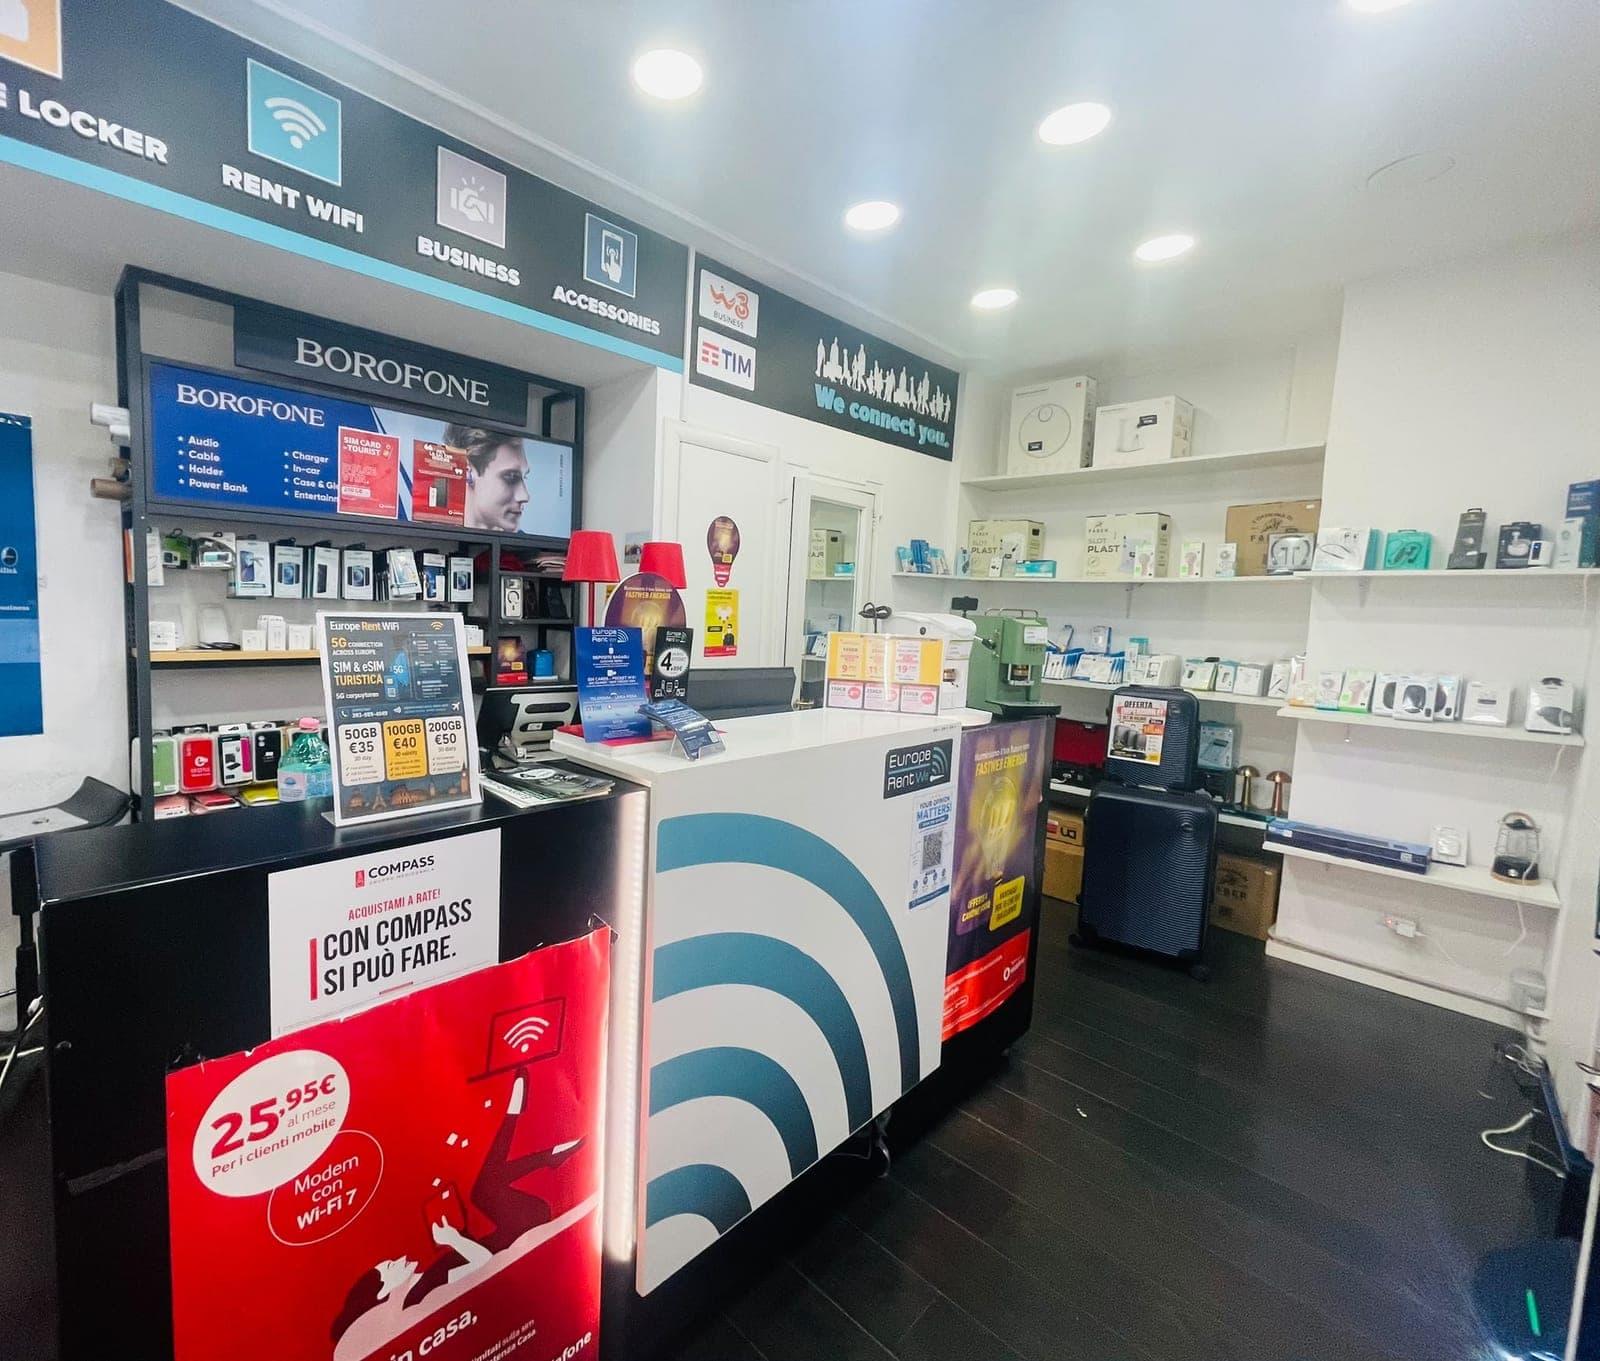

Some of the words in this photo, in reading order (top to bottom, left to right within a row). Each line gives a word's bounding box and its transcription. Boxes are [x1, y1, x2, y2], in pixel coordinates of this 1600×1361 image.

[19, 89, 168, 164] LOCKER
[222, 163, 300, 209] RENT
[305, 195, 364, 233] WIFI
[417, 235, 521, 286] BUSINESS
[552, 285, 661, 335] ACCESSORIES
[713, 311, 744, 329] BUSINESS
[294, 337, 490, 406] BOROFONE
[721, 348, 751, 378] TIM
[176, 383, 325, 427] BOROFONE
[814, 383, 845, 414] We
[850, 402, 915, 436] connect
[919, 424, 950, 448] you.
[188, 435, 219, 448] Audio
[344, 436, 359, 445] SIM
[360, 439, 381, 449] CARD
[188, 450, 220, 462] Cable
[292, 451, 328, 464] Charger
[189, 464, 224, 477] Holder
[292, 464, 320, 476] In-car
[189, 478, 220, 491] Power
[223, 482, 248, 493] Bank
[293, 477, 316, 488] Case
[318, 479, 325, 488] &
[1087, 544, 1120, 553] PLAST
[330, 620, 361, 632] Europe
[361, 621, 381, 631] Rent
[331, 637, 347, 648] 5G
[333, 661, 352, 673] SIM
[353, 661, 361, 672] &
[362, 661, 385, 672] eSIM
[393, 665, 404, 674] 5G
[334, 674, 384, 686] TURISTICA
[1124, 700, 1153, 709] OFFERTA
[344, 728, 378, 740] 50GB
[386, 723, 422, 736] 100GB
[428, 720, 462, 733] 200GB
[349, 741, 375, 754] €35
[393, 737, 417, 750] €40
[434, 733, 457, 745] €50
[368, 855, 435, 878] COMPASS
[348, 897, 405, 920] ACQUISTAMI
[408, 896, 414, 905] A
[416, 888, 441, 903] RATE!
[323, 924, 369, 961] CON
[376, 898, 472, 946] COMPASS
[323, 966, 345, 995] SI
[352, 948, 395, 987] PUÒ
[401, 935, 457, 973] FARE.
[210, 1074, 336, 1160] 25,95€
[287, 1115, 299, 1128] al
[301, 1100, 336, 1121] mese
[211, 1159, 236, 1177] Per
[238, 1153, 244, 1166] i
[246, 1136, 290, 1162] clienti
[292, 1117, 336, 1144] mobile
[294, 1155, 359, 1195] Modem
[311, 1177, 343, 1203] con
[296, 1195, 342, 1230] Wi-Fi
[346, 1188, 358, 1205] 7
[419, 1310, 478, 1356] casa,
[501, 1329, 520, 1346] sulla
[517, 1329, 536, 1346] Casa
